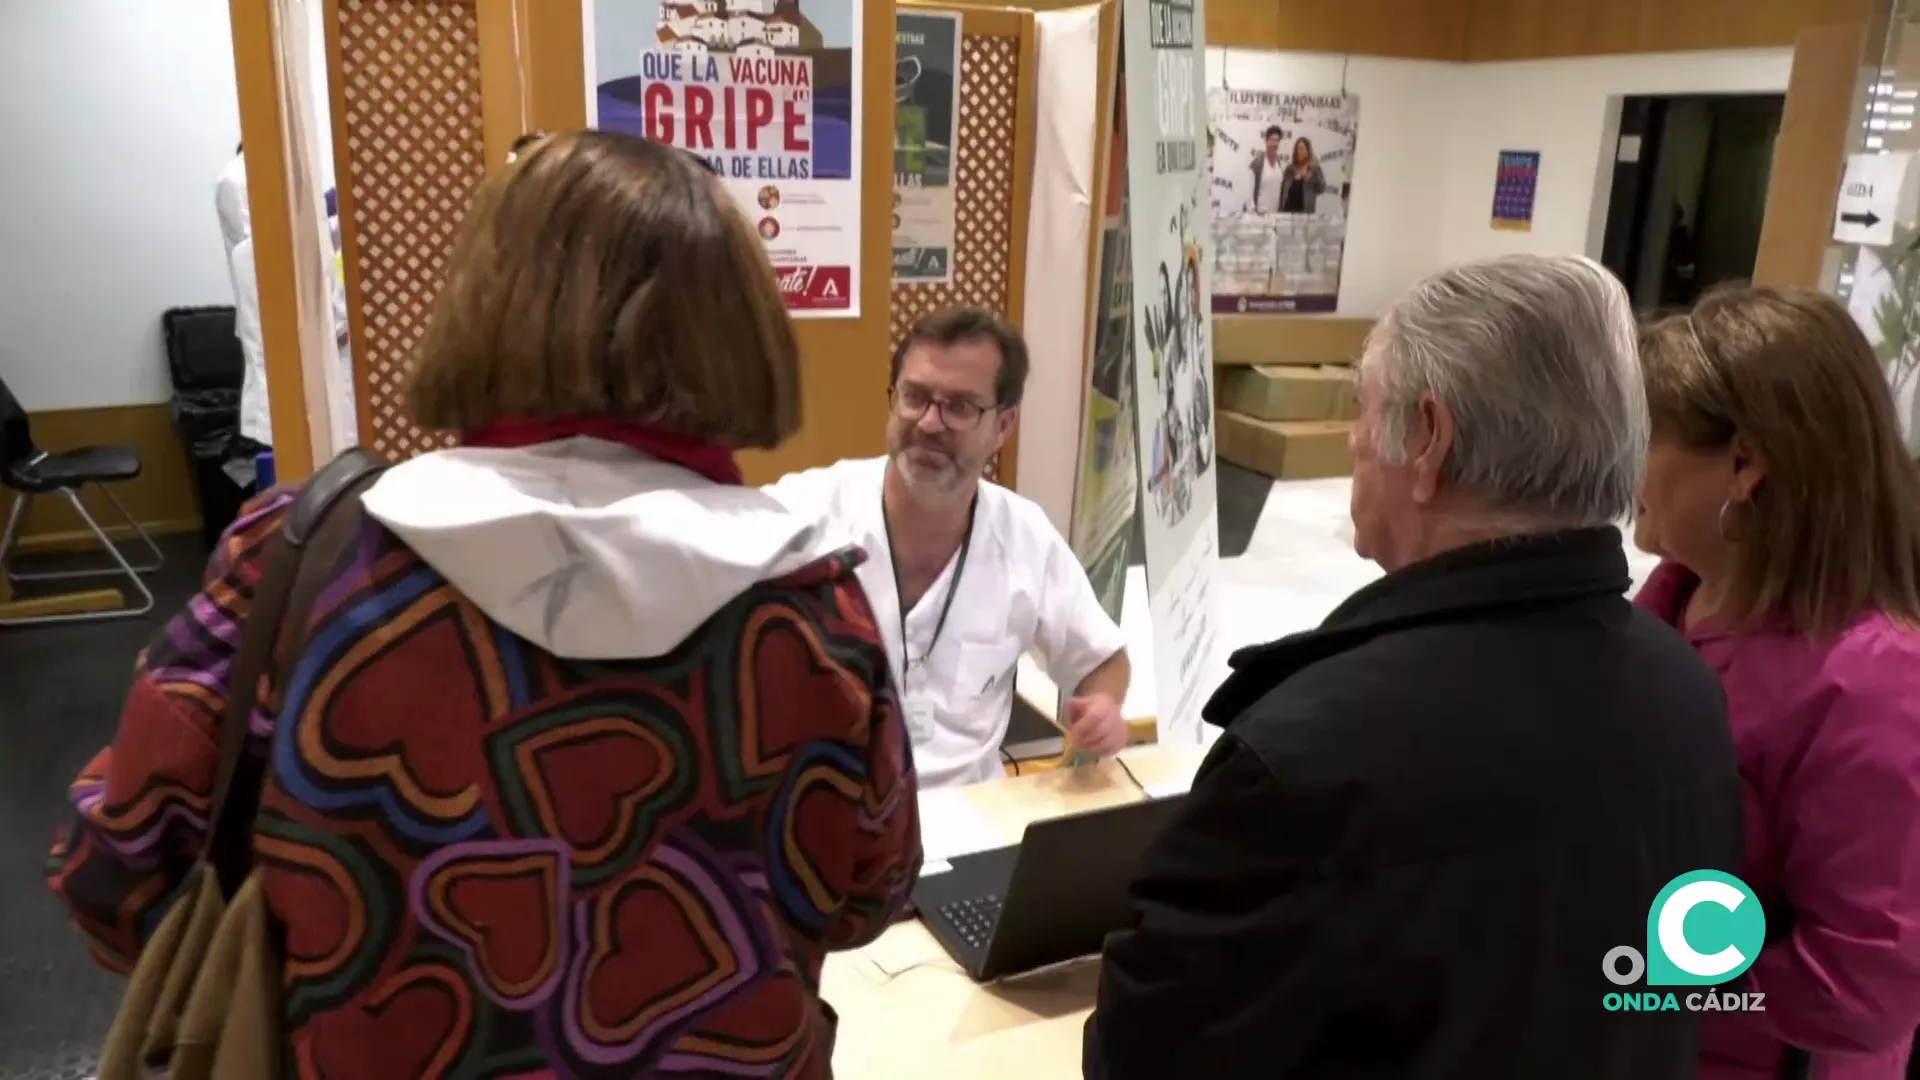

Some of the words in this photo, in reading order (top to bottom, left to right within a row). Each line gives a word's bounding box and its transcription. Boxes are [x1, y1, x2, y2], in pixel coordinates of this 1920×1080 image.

[643, 52, 682, 80] QUE
[692, 55, 719, 83] LA
[729, 58, 810, 87] VACUNA
[644, 82, 810, 152] GRIPE
[732, 155, 752, 178] DE
[758, 156, 809, 179] ELLAS
